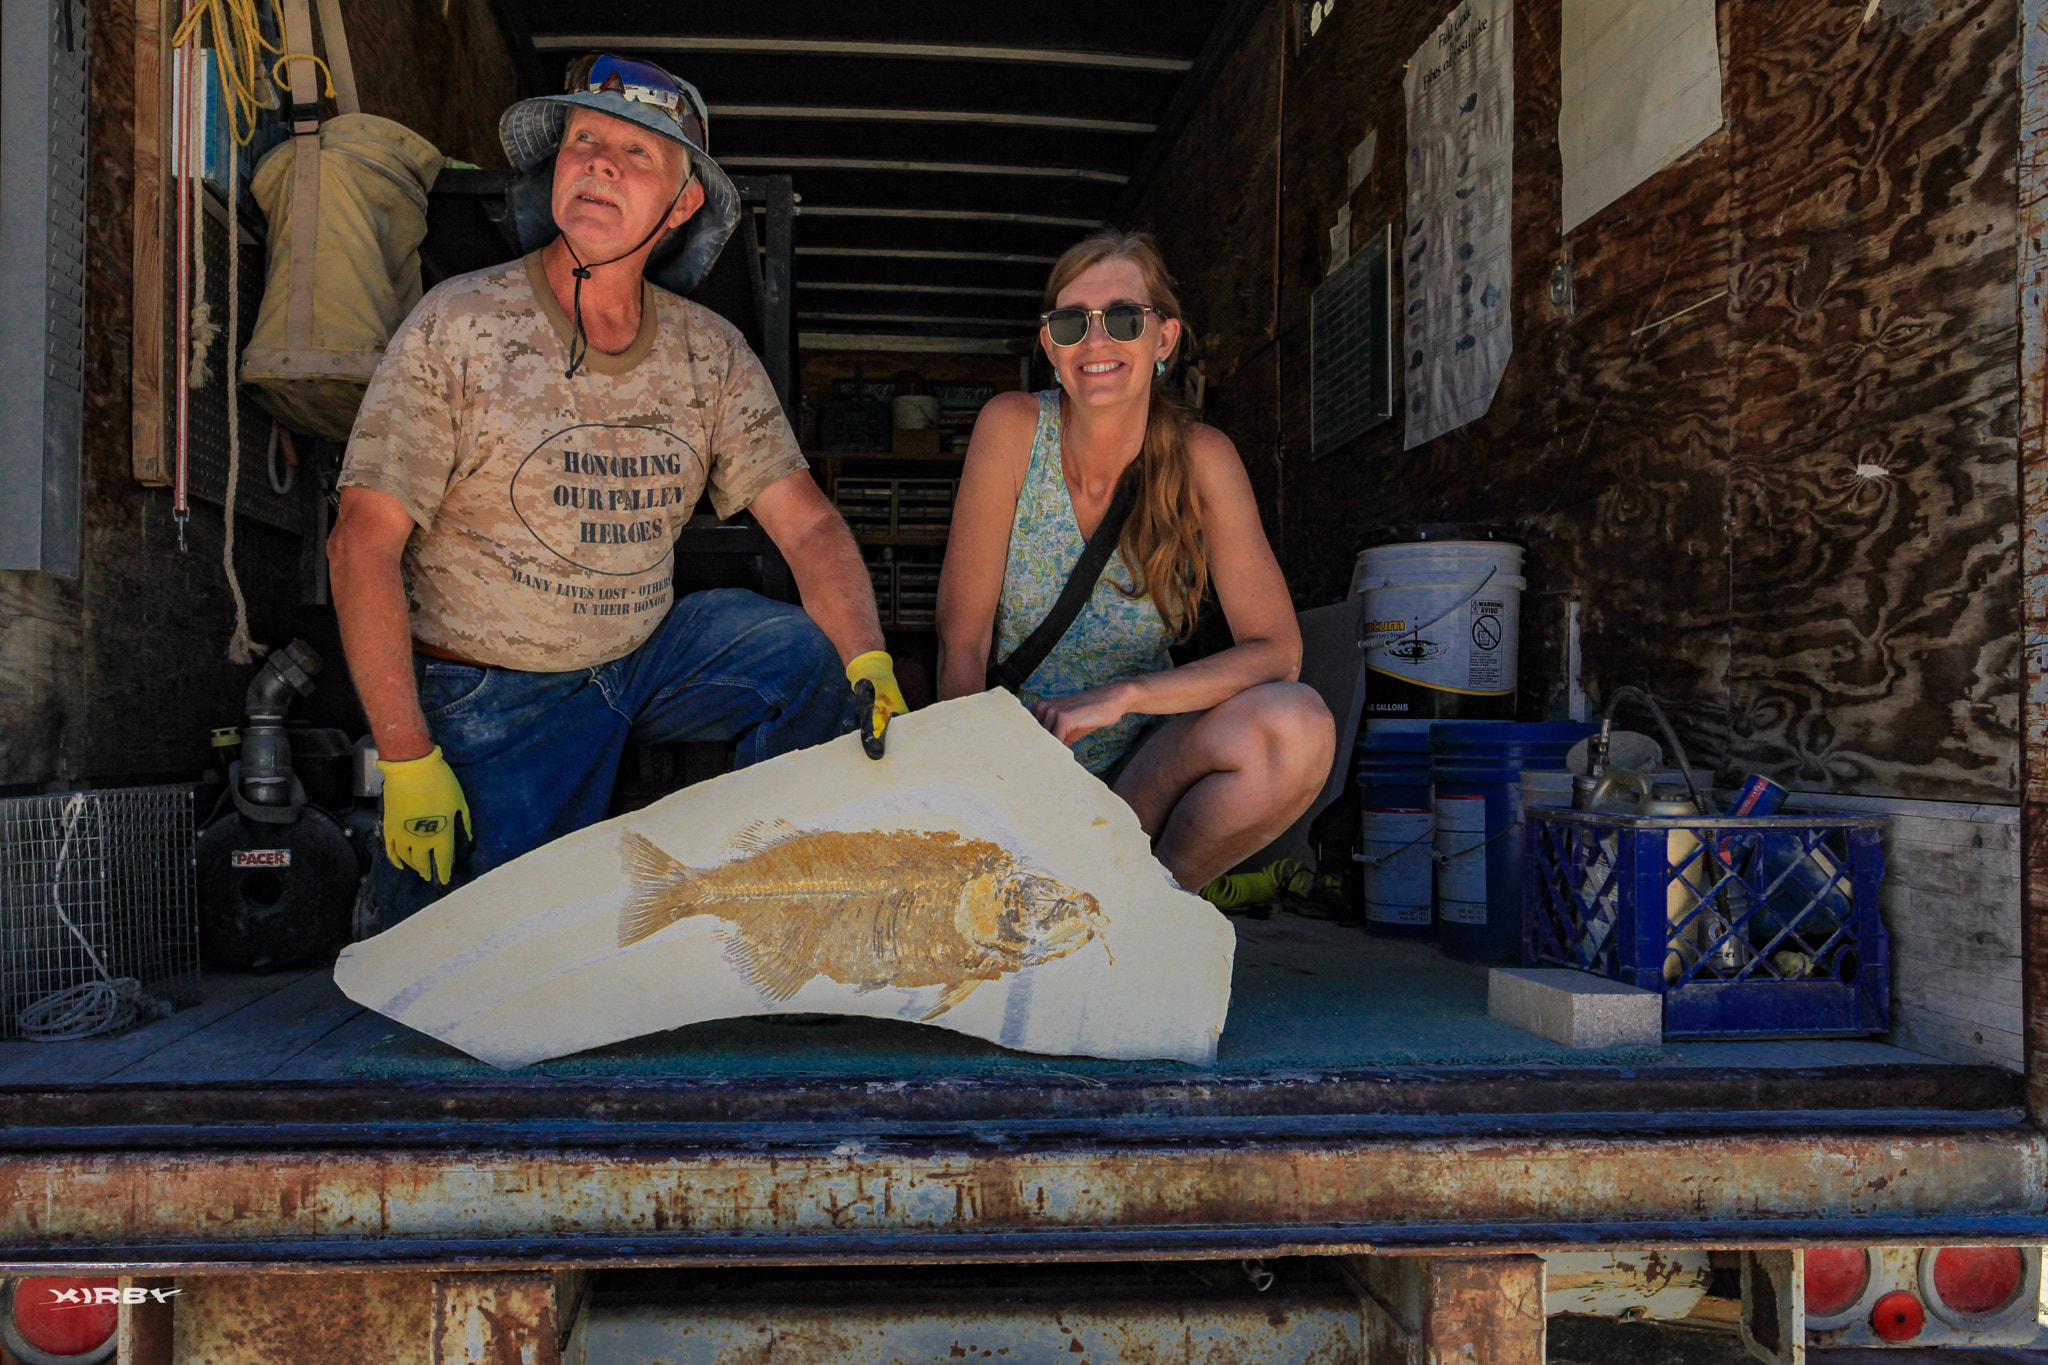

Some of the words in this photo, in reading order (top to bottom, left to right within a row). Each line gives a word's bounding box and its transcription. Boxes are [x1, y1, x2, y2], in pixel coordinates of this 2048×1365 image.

[563, 450, 681, 478] HONORING
[553, 484, 603, 511] OUR
[608, 486, 686, 511] FALLEN
[580, 518, 663, 544] HEROES
[510, 568, 552, 593] MANY
[556, 583, 595, 600] LIVES
[599, 587, 628, 600] LOST
[573, 602, 588, 615] IN
[592, 602, 630, 616] THEIR
[634, 593, 667, 613] HONOR
[1376, 703, 1408, 712] GALLONS
[413, 819, 439, 833] FG
[236, 852, 286, 866] PACER
